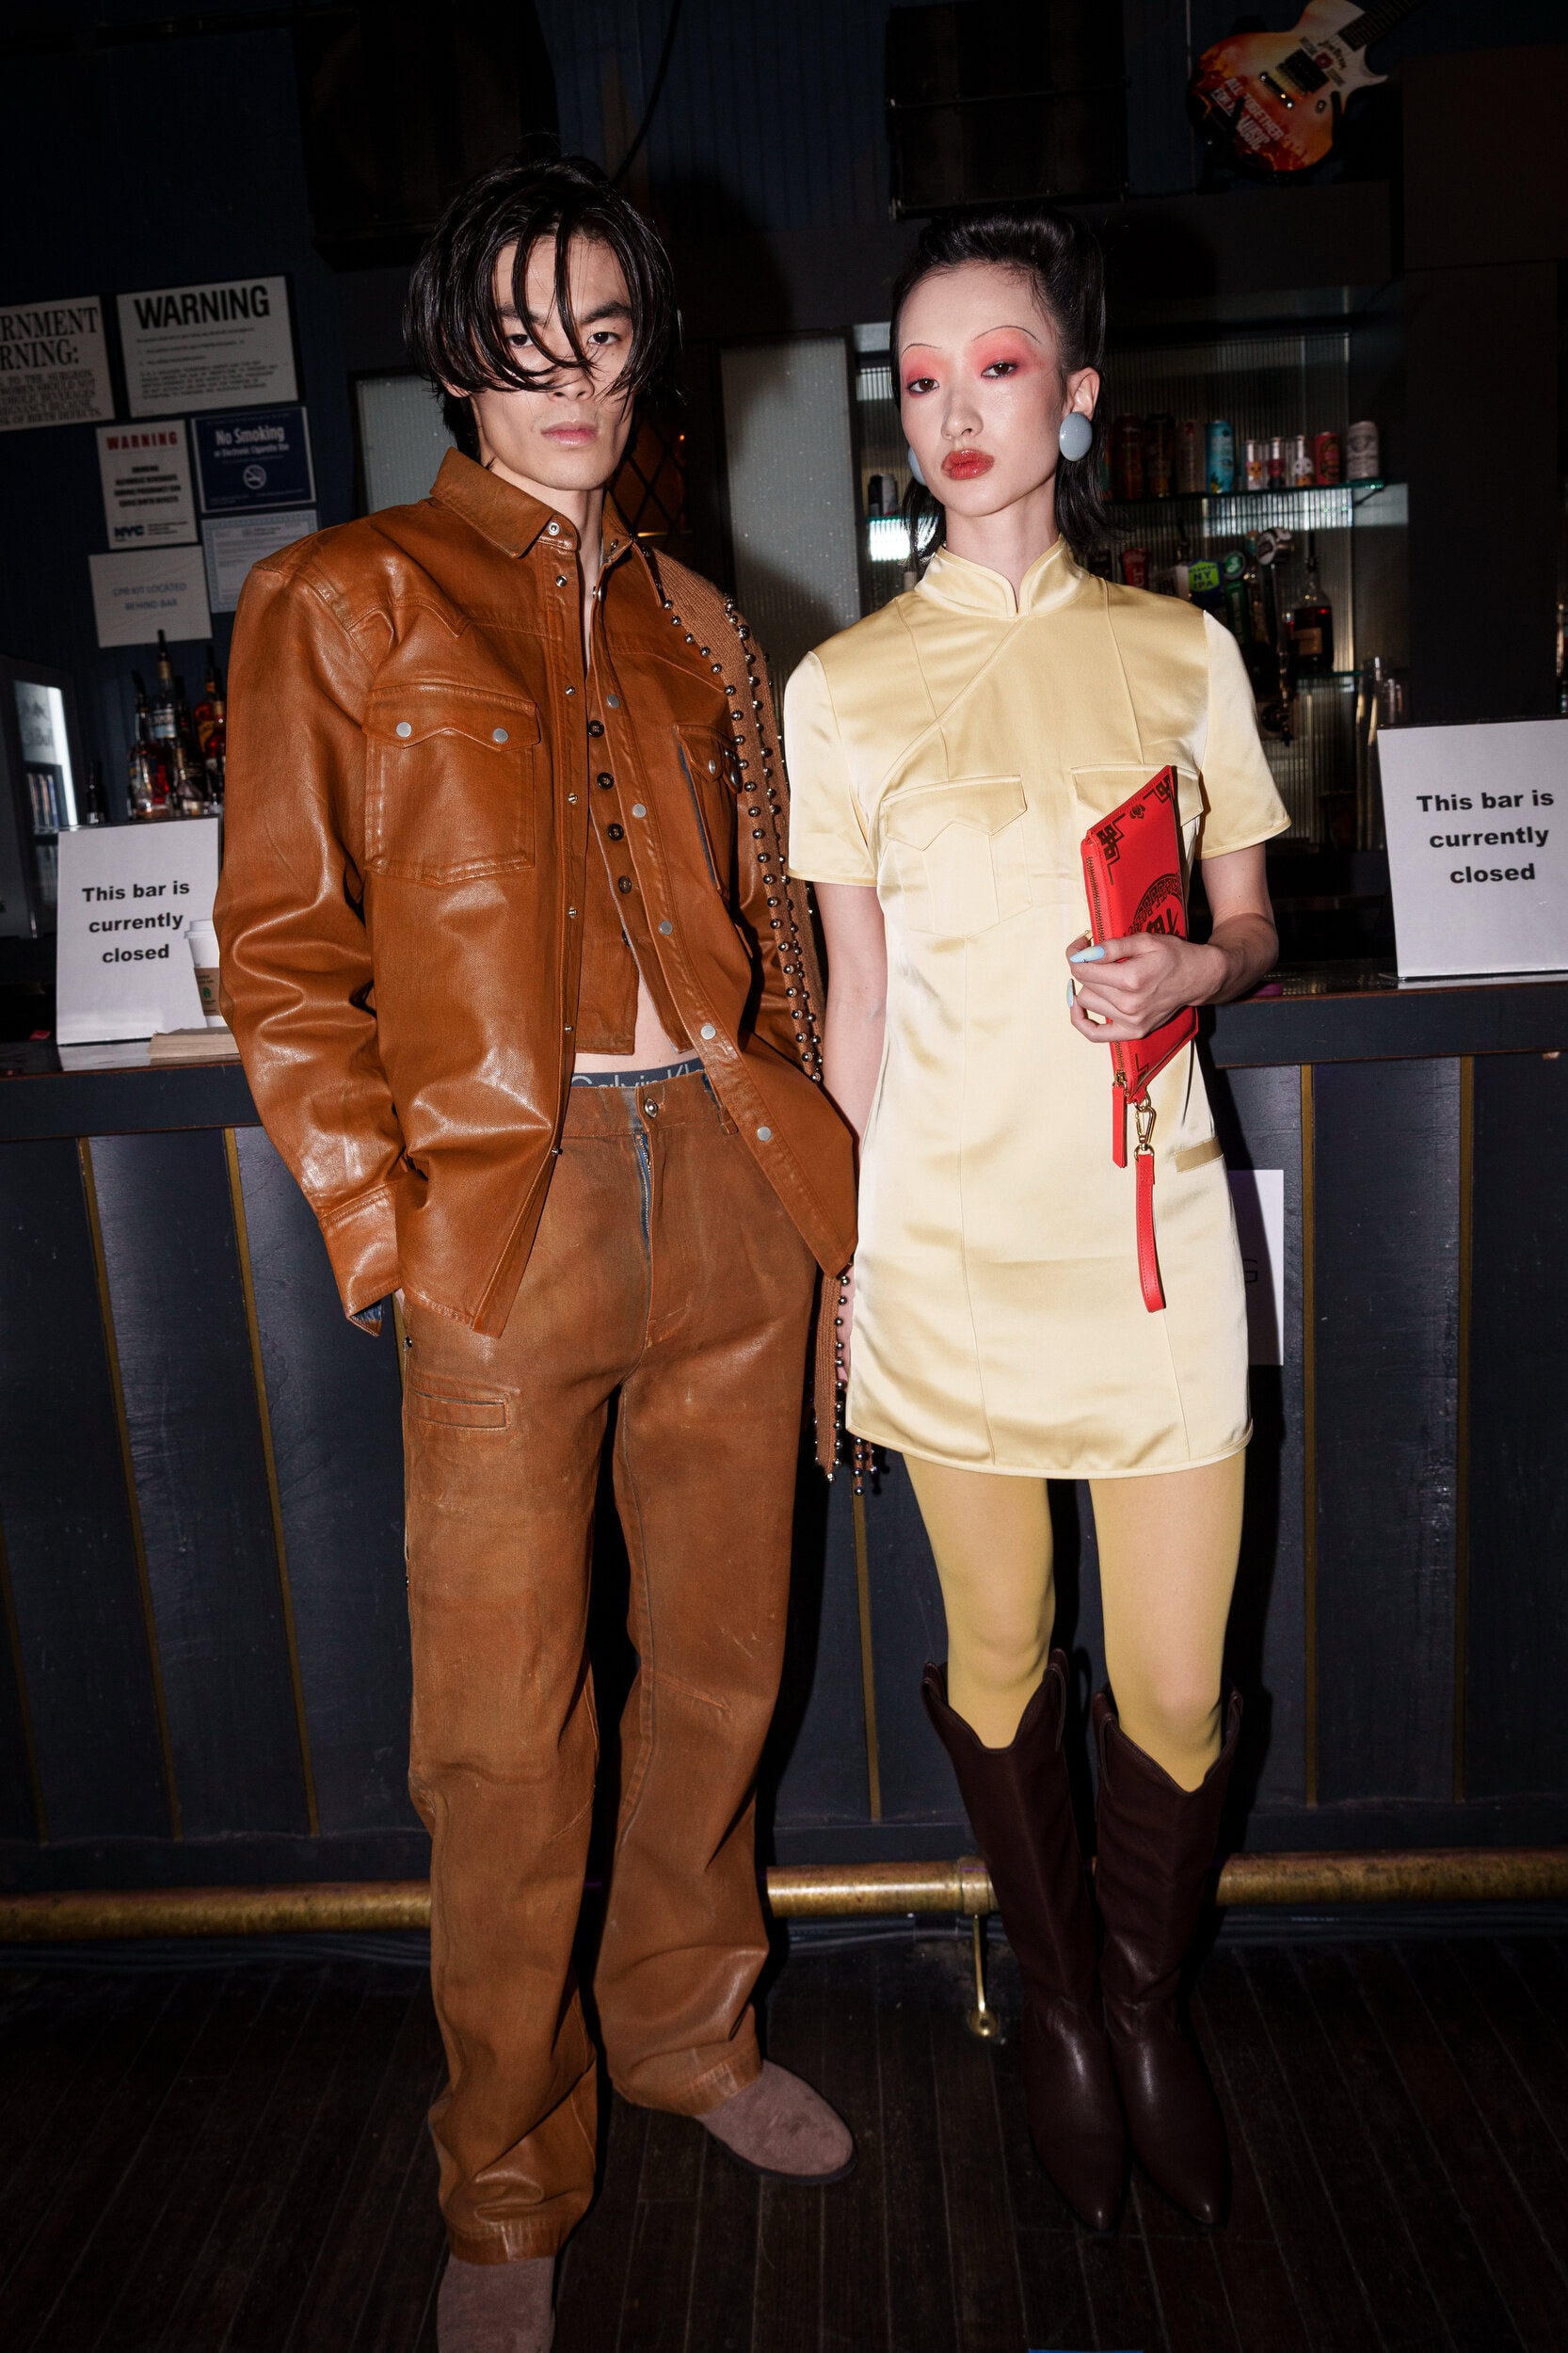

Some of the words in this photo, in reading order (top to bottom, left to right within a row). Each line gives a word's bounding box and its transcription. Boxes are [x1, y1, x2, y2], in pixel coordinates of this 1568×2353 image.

[1224, 77, 1244, 96] ALL
[135, 285, 270, 329] WARNING
[0, 339, 79, 370] RNING:
[106, 431, 178, 451] WARNING
[215, 429, 233, 446] No
[232, 424, 285, 445] Smoking
[114, 525, 145, 537] NYC
[1194, 571, 1210, 581] NY
[147, 582, 187, 594] LOCATED
[1416, 792, 1473, 812] This
[1481, 791, 1524, 809] bar
[1532, 790, 1555, 807] is
[1430, 825, 1549, 848] currently
[1449, 863, 1536, 884] closed
[82, 885, 125, 903] This
[133, 882, 167, 899] bar
[173, 880, 190, 895] is
[88, 912, 184, 933] currently
[103, 943, 169, 964] closed
